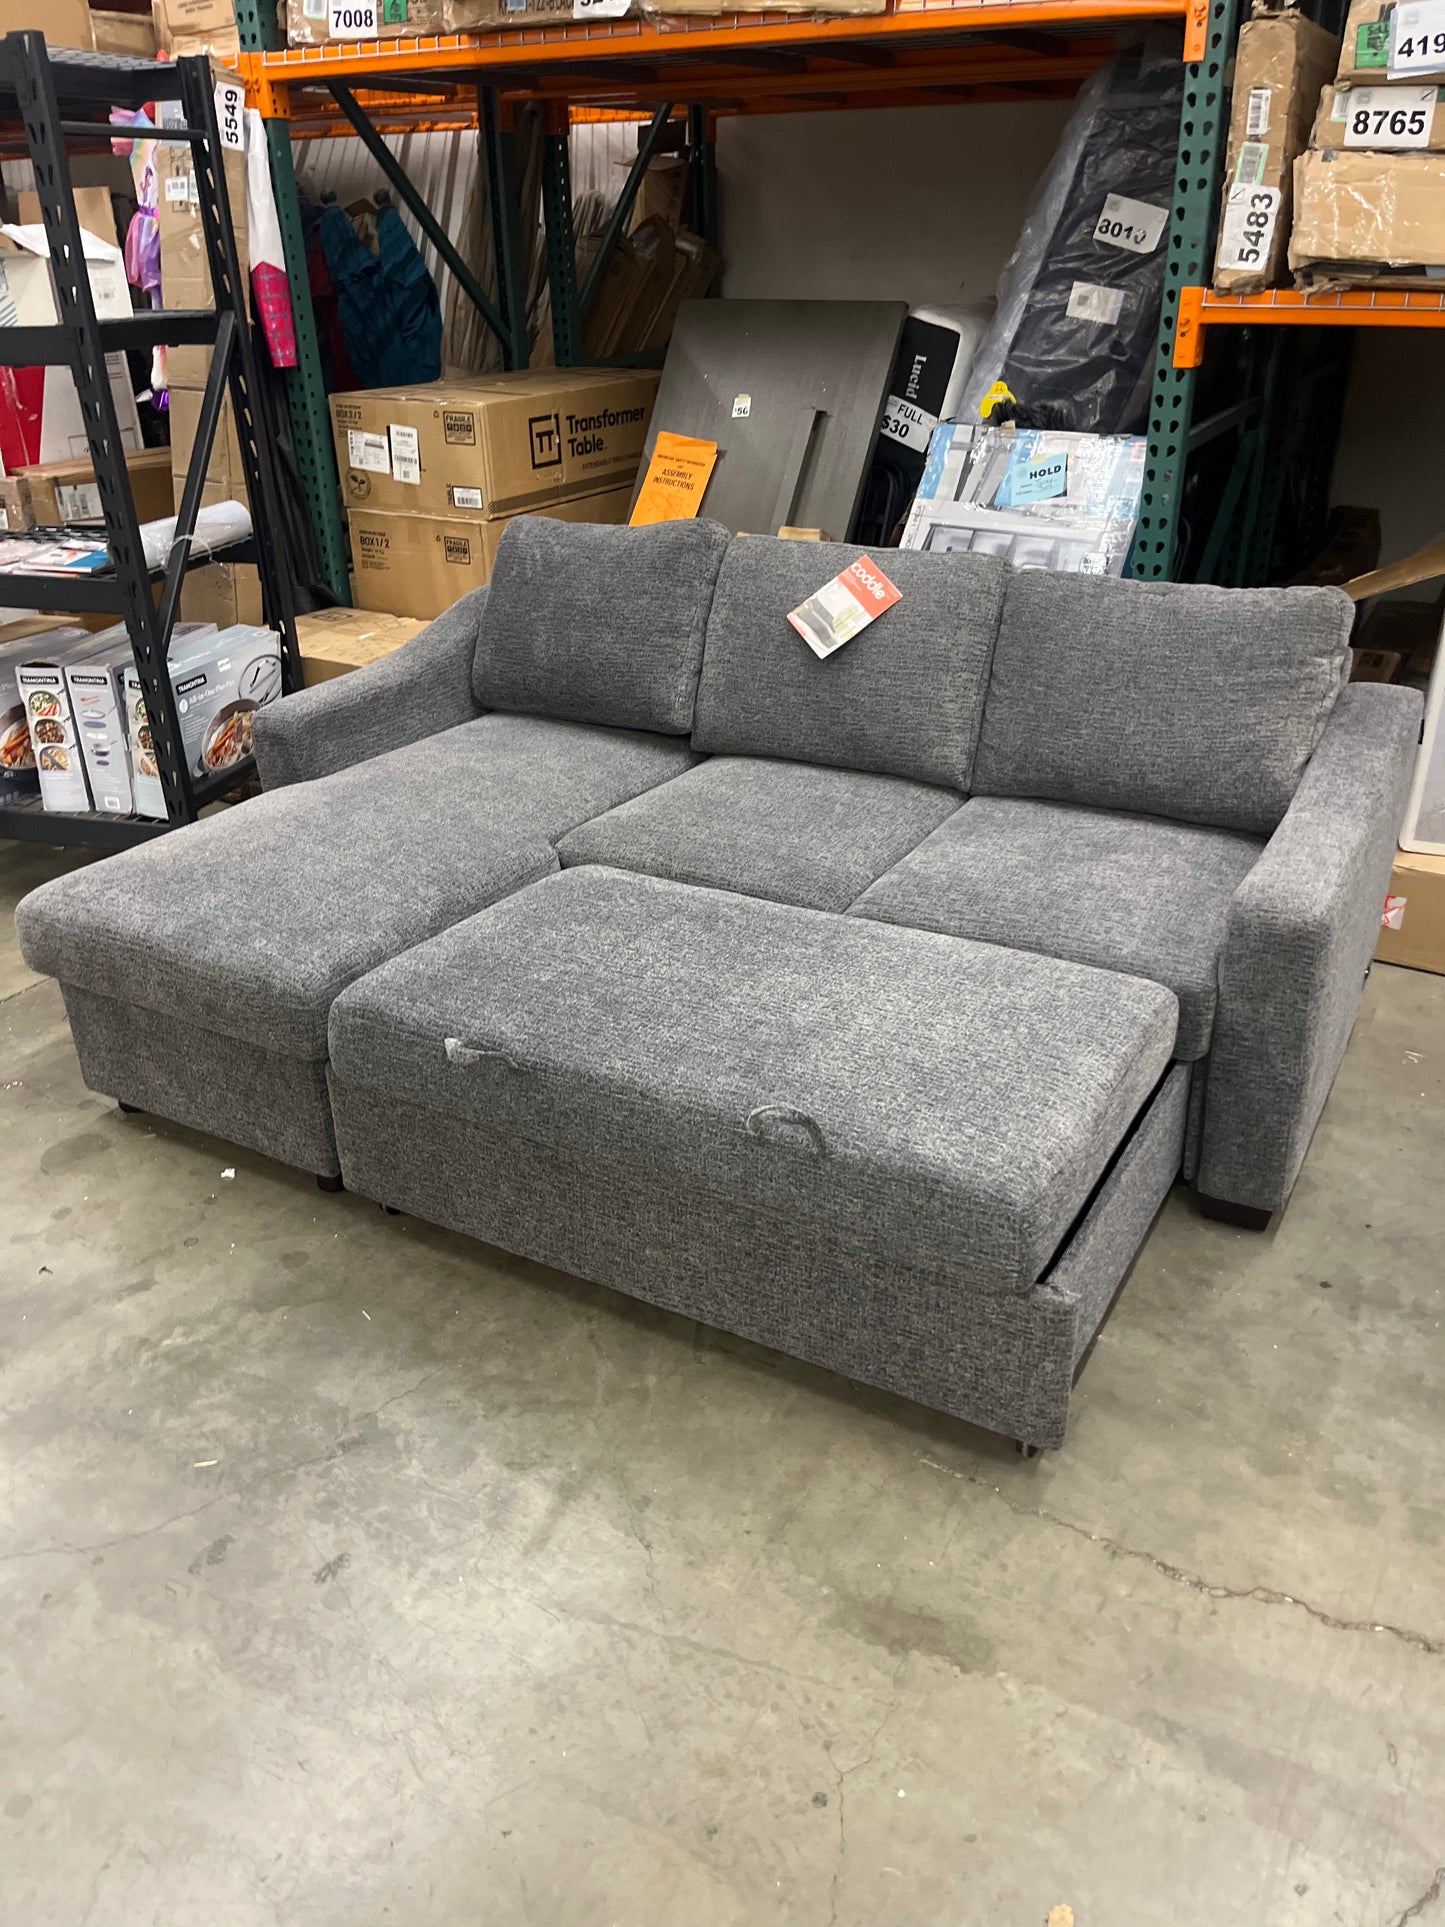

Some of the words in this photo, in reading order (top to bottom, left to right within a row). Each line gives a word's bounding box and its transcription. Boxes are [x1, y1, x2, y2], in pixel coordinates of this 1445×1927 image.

[333, 9, 374, 28] 7008
[225, 89, 239, 144] 5549
[1352, 110, 1426, 135] 8765
[1237, 193, 1273, 263] 5483
[906, 354, 927, 400] Lucid
[446, 414, 471, 423] FRAGILE
[566, 407, 646, 435] Transformer
[896, 403, 923, 425] FULL
[881, 414, 910, 438] $30
[661, 468, 694, 480] ASSEMBLY
[1029, 464, 1062, 480] HOLD
[653, 476, 695, 491] INSTRUCTIONS
[359, 535, 375, 546] BOX
[851, 563, 886, 600] coddle
[22, 676, 56, 684] TRAMONTINA
[73, 676, 105, 684] TRAMONTINA
[178, 677, 206, 693] TRAMONTINA
